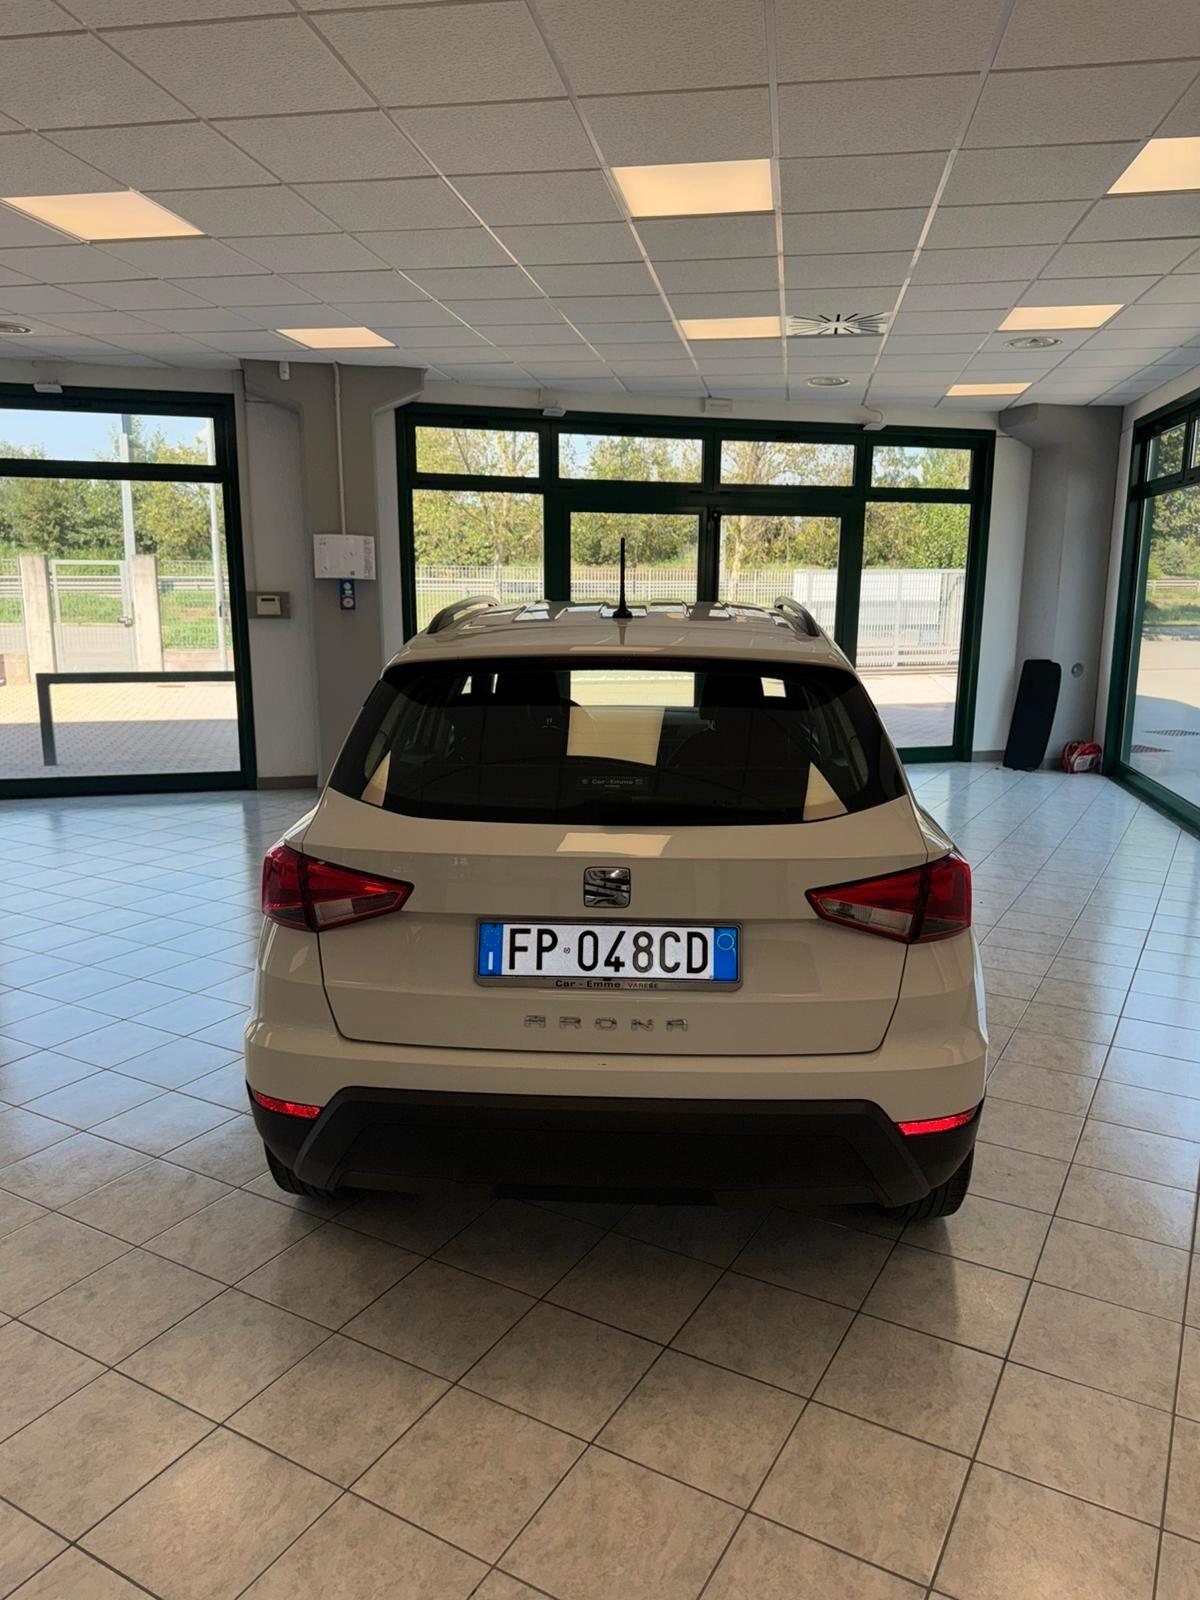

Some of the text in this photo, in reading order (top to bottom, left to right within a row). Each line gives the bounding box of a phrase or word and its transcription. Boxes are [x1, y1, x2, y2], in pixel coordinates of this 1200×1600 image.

[508, 928, 709, 974] FP 048CD
[555, 980, 576, 989] Car
[586, 980, 621, 989] Emme
[523, 1014, 689, 1032] ARONA
